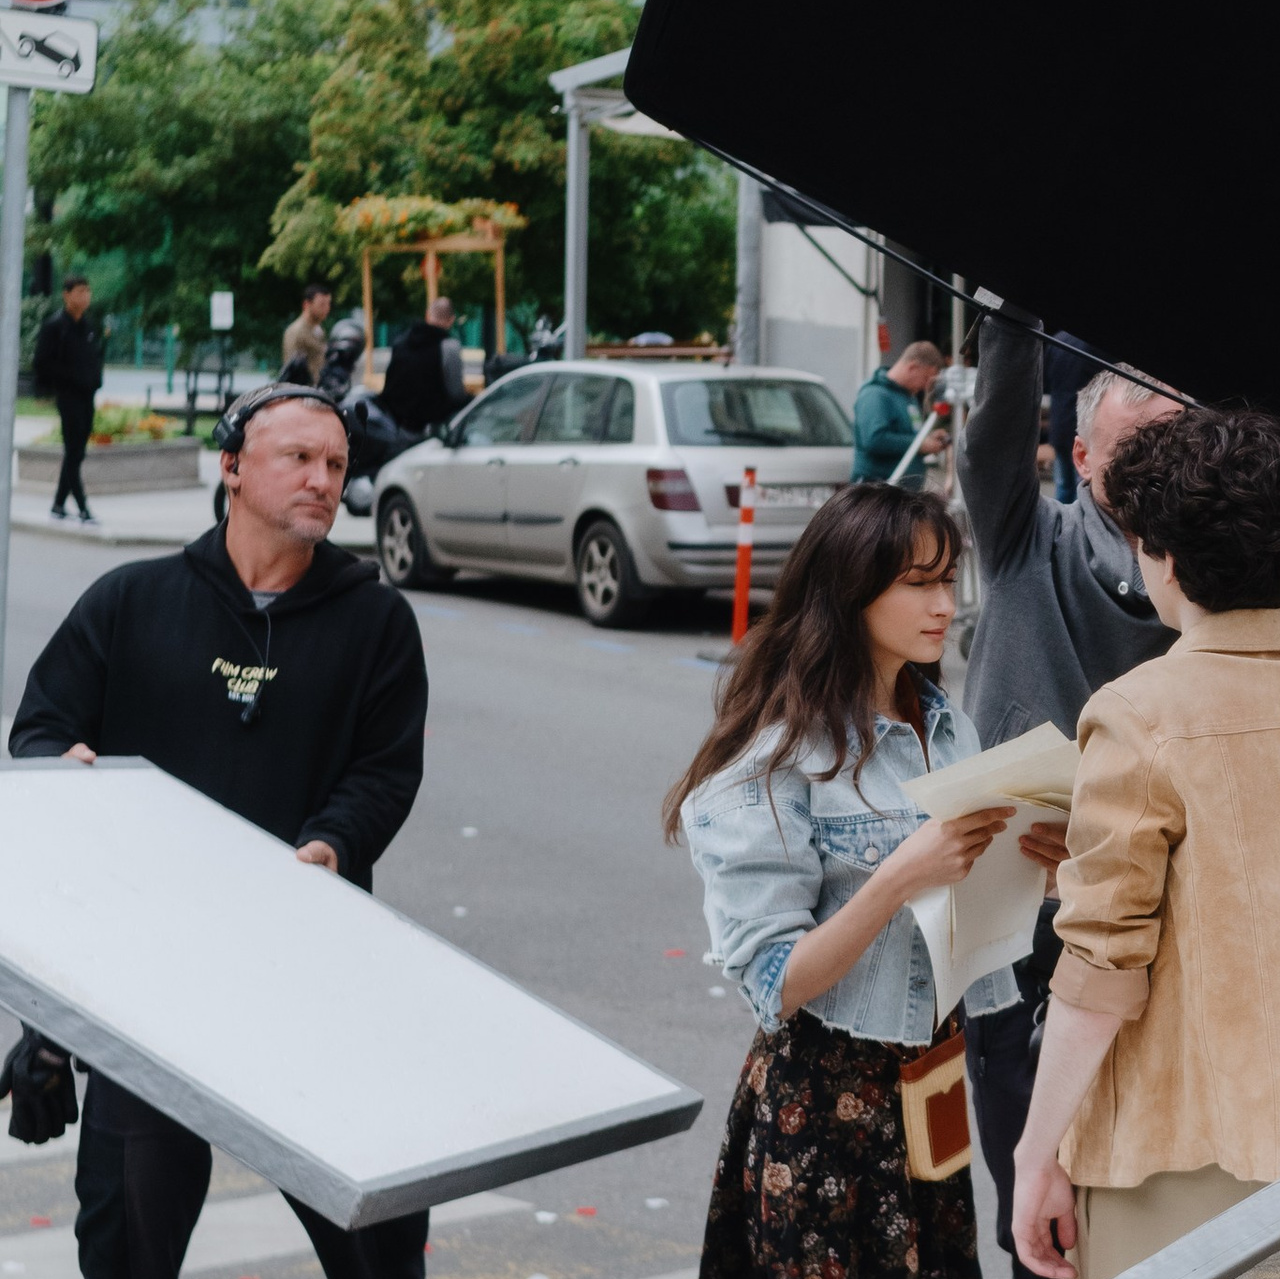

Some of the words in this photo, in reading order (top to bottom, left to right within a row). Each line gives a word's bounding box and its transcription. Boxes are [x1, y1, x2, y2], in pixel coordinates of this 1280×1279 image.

[211, 657, 241, 678] FILM
[241, 666, 278, 681] CREW
[227, 677, 260, 694] CLUB
